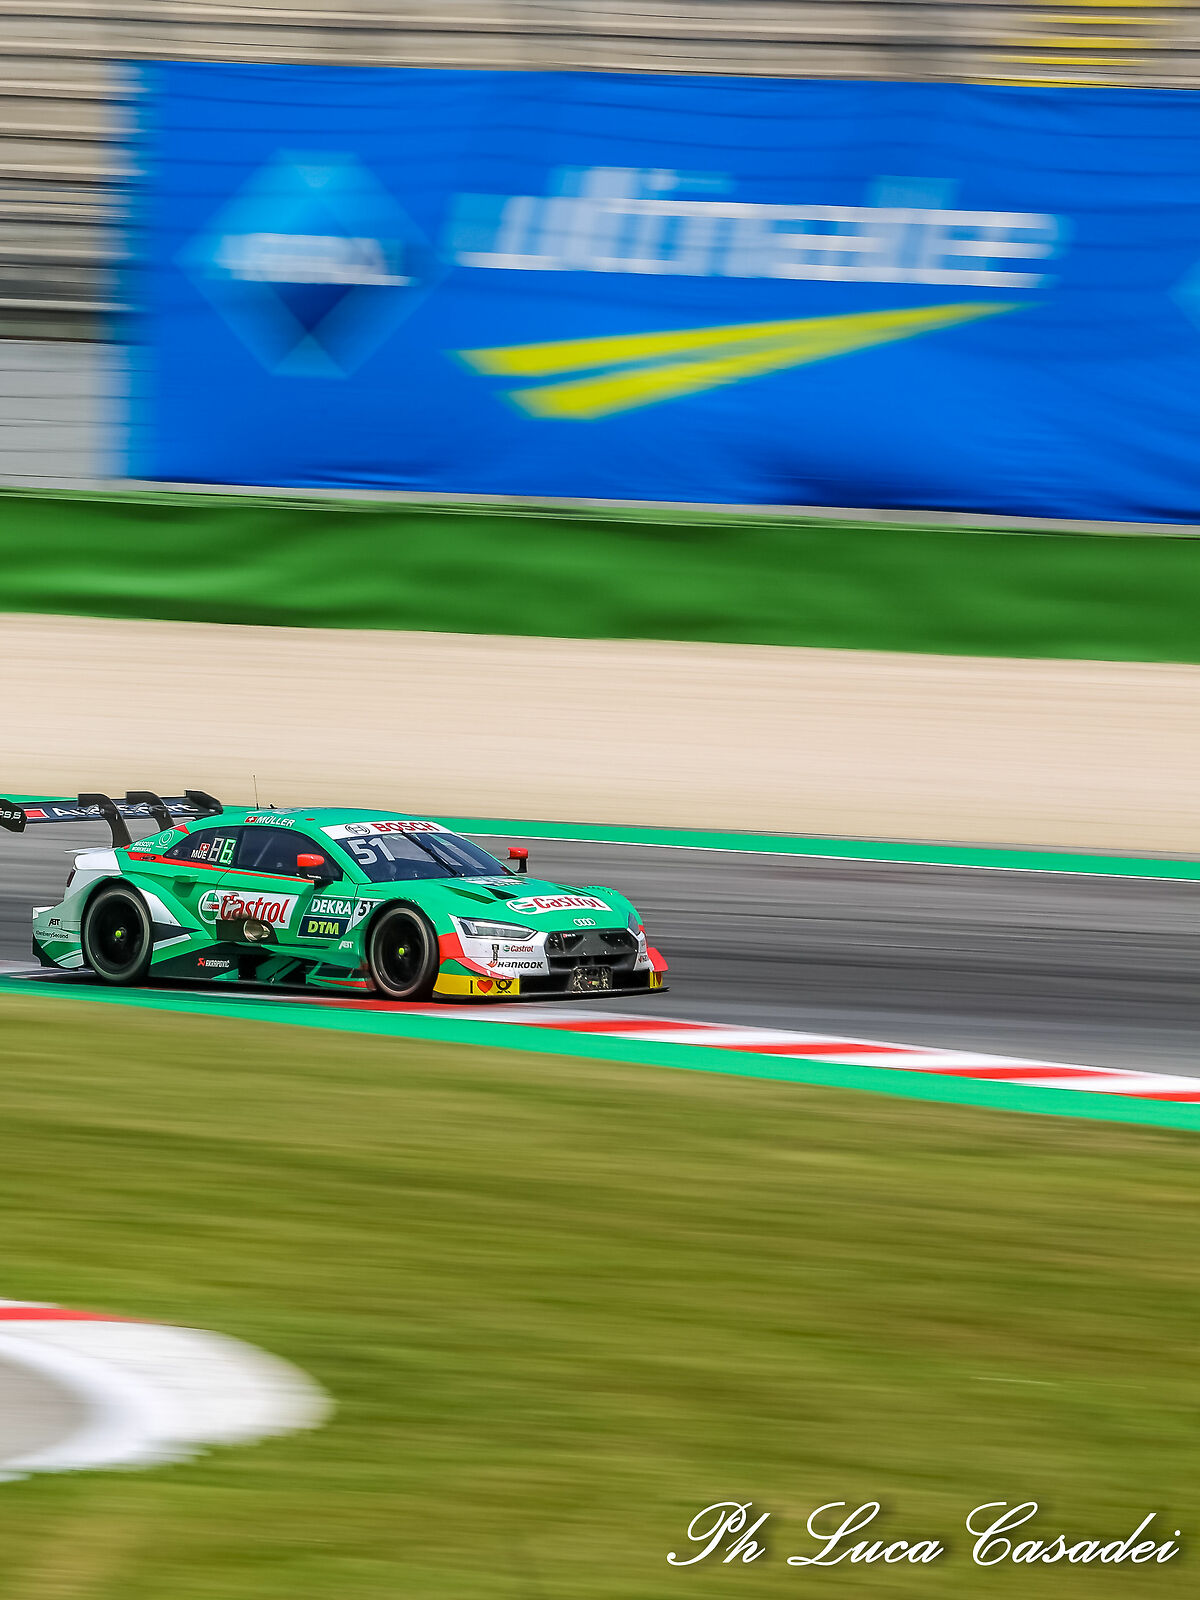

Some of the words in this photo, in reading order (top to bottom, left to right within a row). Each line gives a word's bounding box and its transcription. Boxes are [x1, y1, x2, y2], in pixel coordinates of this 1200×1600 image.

[256, 815, 296, 827] MÜLLER
[371, 822, 440, 832] BOSCH
[347, 837, 396, 865] 51
[220, 895, 291, 923] Castrol
[310, 898, 352, 915] DEKRA
[532, 896, 606, 910] Castrol
[48, 918, 61, 927] ABT
[307, 920, 340, 935] DTM
[510, 944, 535, 953] Castrol
